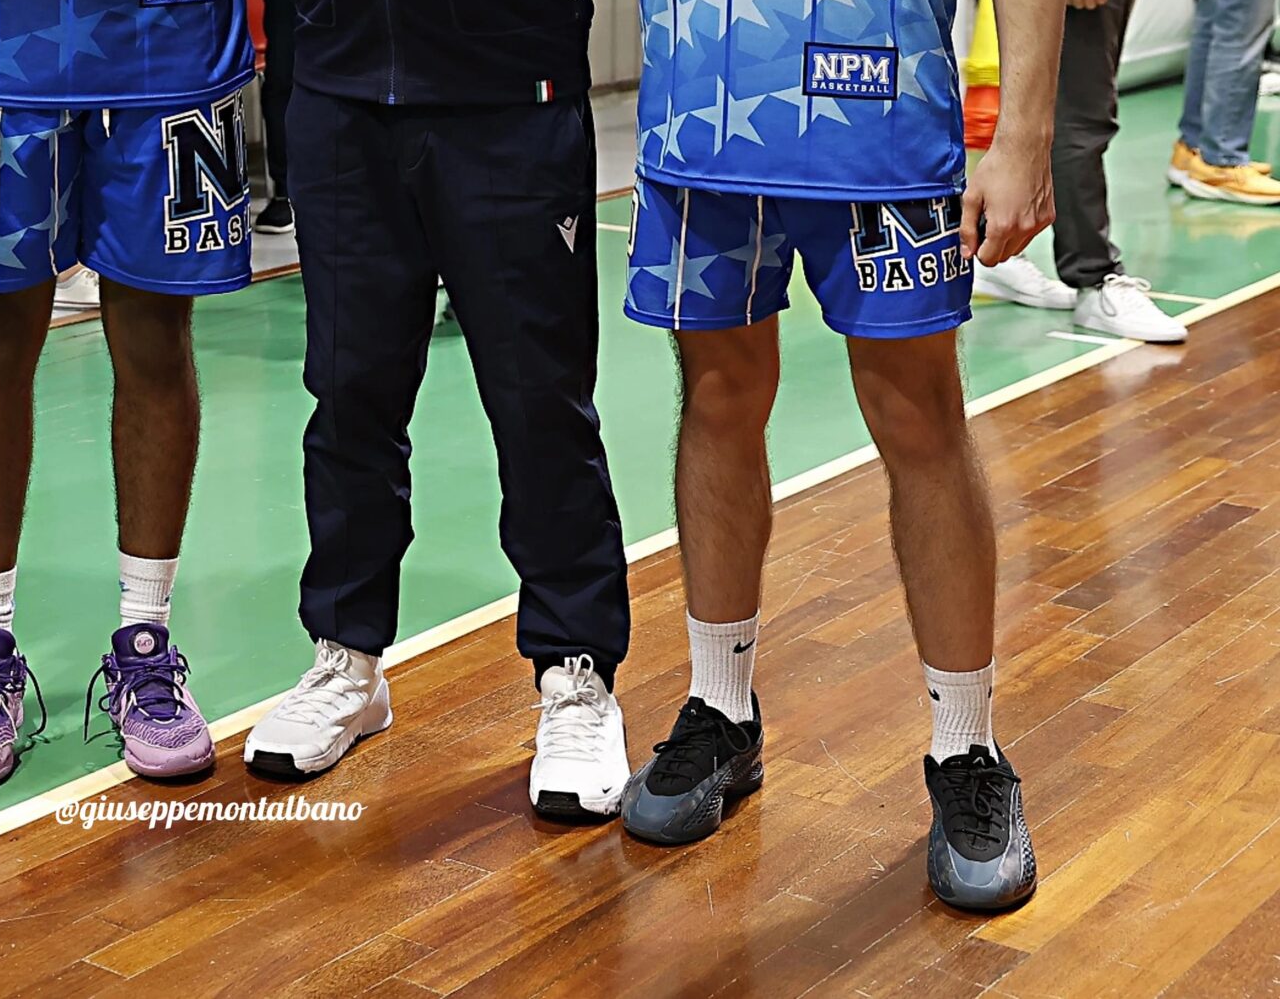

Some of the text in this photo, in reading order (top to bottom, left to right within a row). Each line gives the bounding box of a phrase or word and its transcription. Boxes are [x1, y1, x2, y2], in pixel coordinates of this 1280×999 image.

[812, 52, 891, 85] NPM
[811, 80, 890, 94] BASKETBALL
[164, 202, 253, 254] BAS
